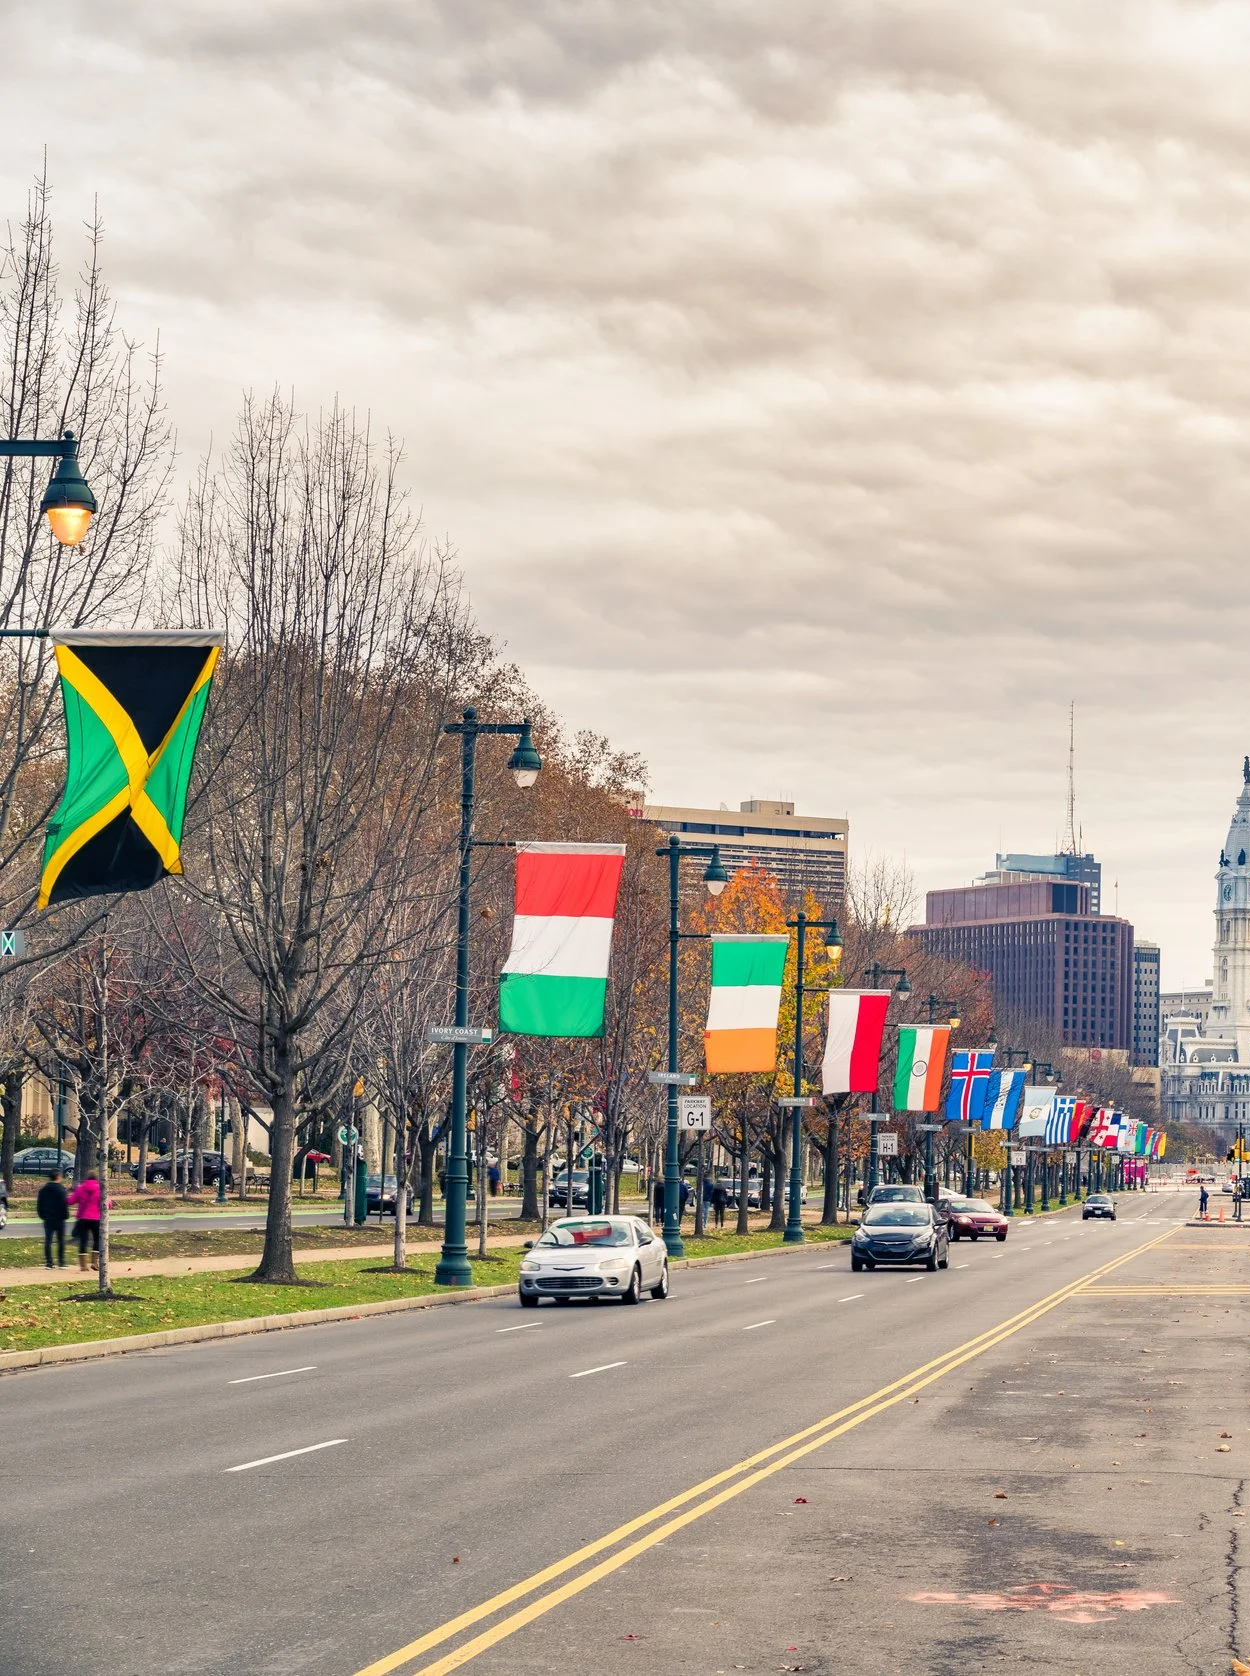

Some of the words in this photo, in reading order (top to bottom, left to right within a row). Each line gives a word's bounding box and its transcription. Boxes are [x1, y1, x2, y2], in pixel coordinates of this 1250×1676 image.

[431, 1027, 453, 1035] IVORY
[687, 1111, 704, 1127] G-1
[882, 1143, 894, 1153] H-1
